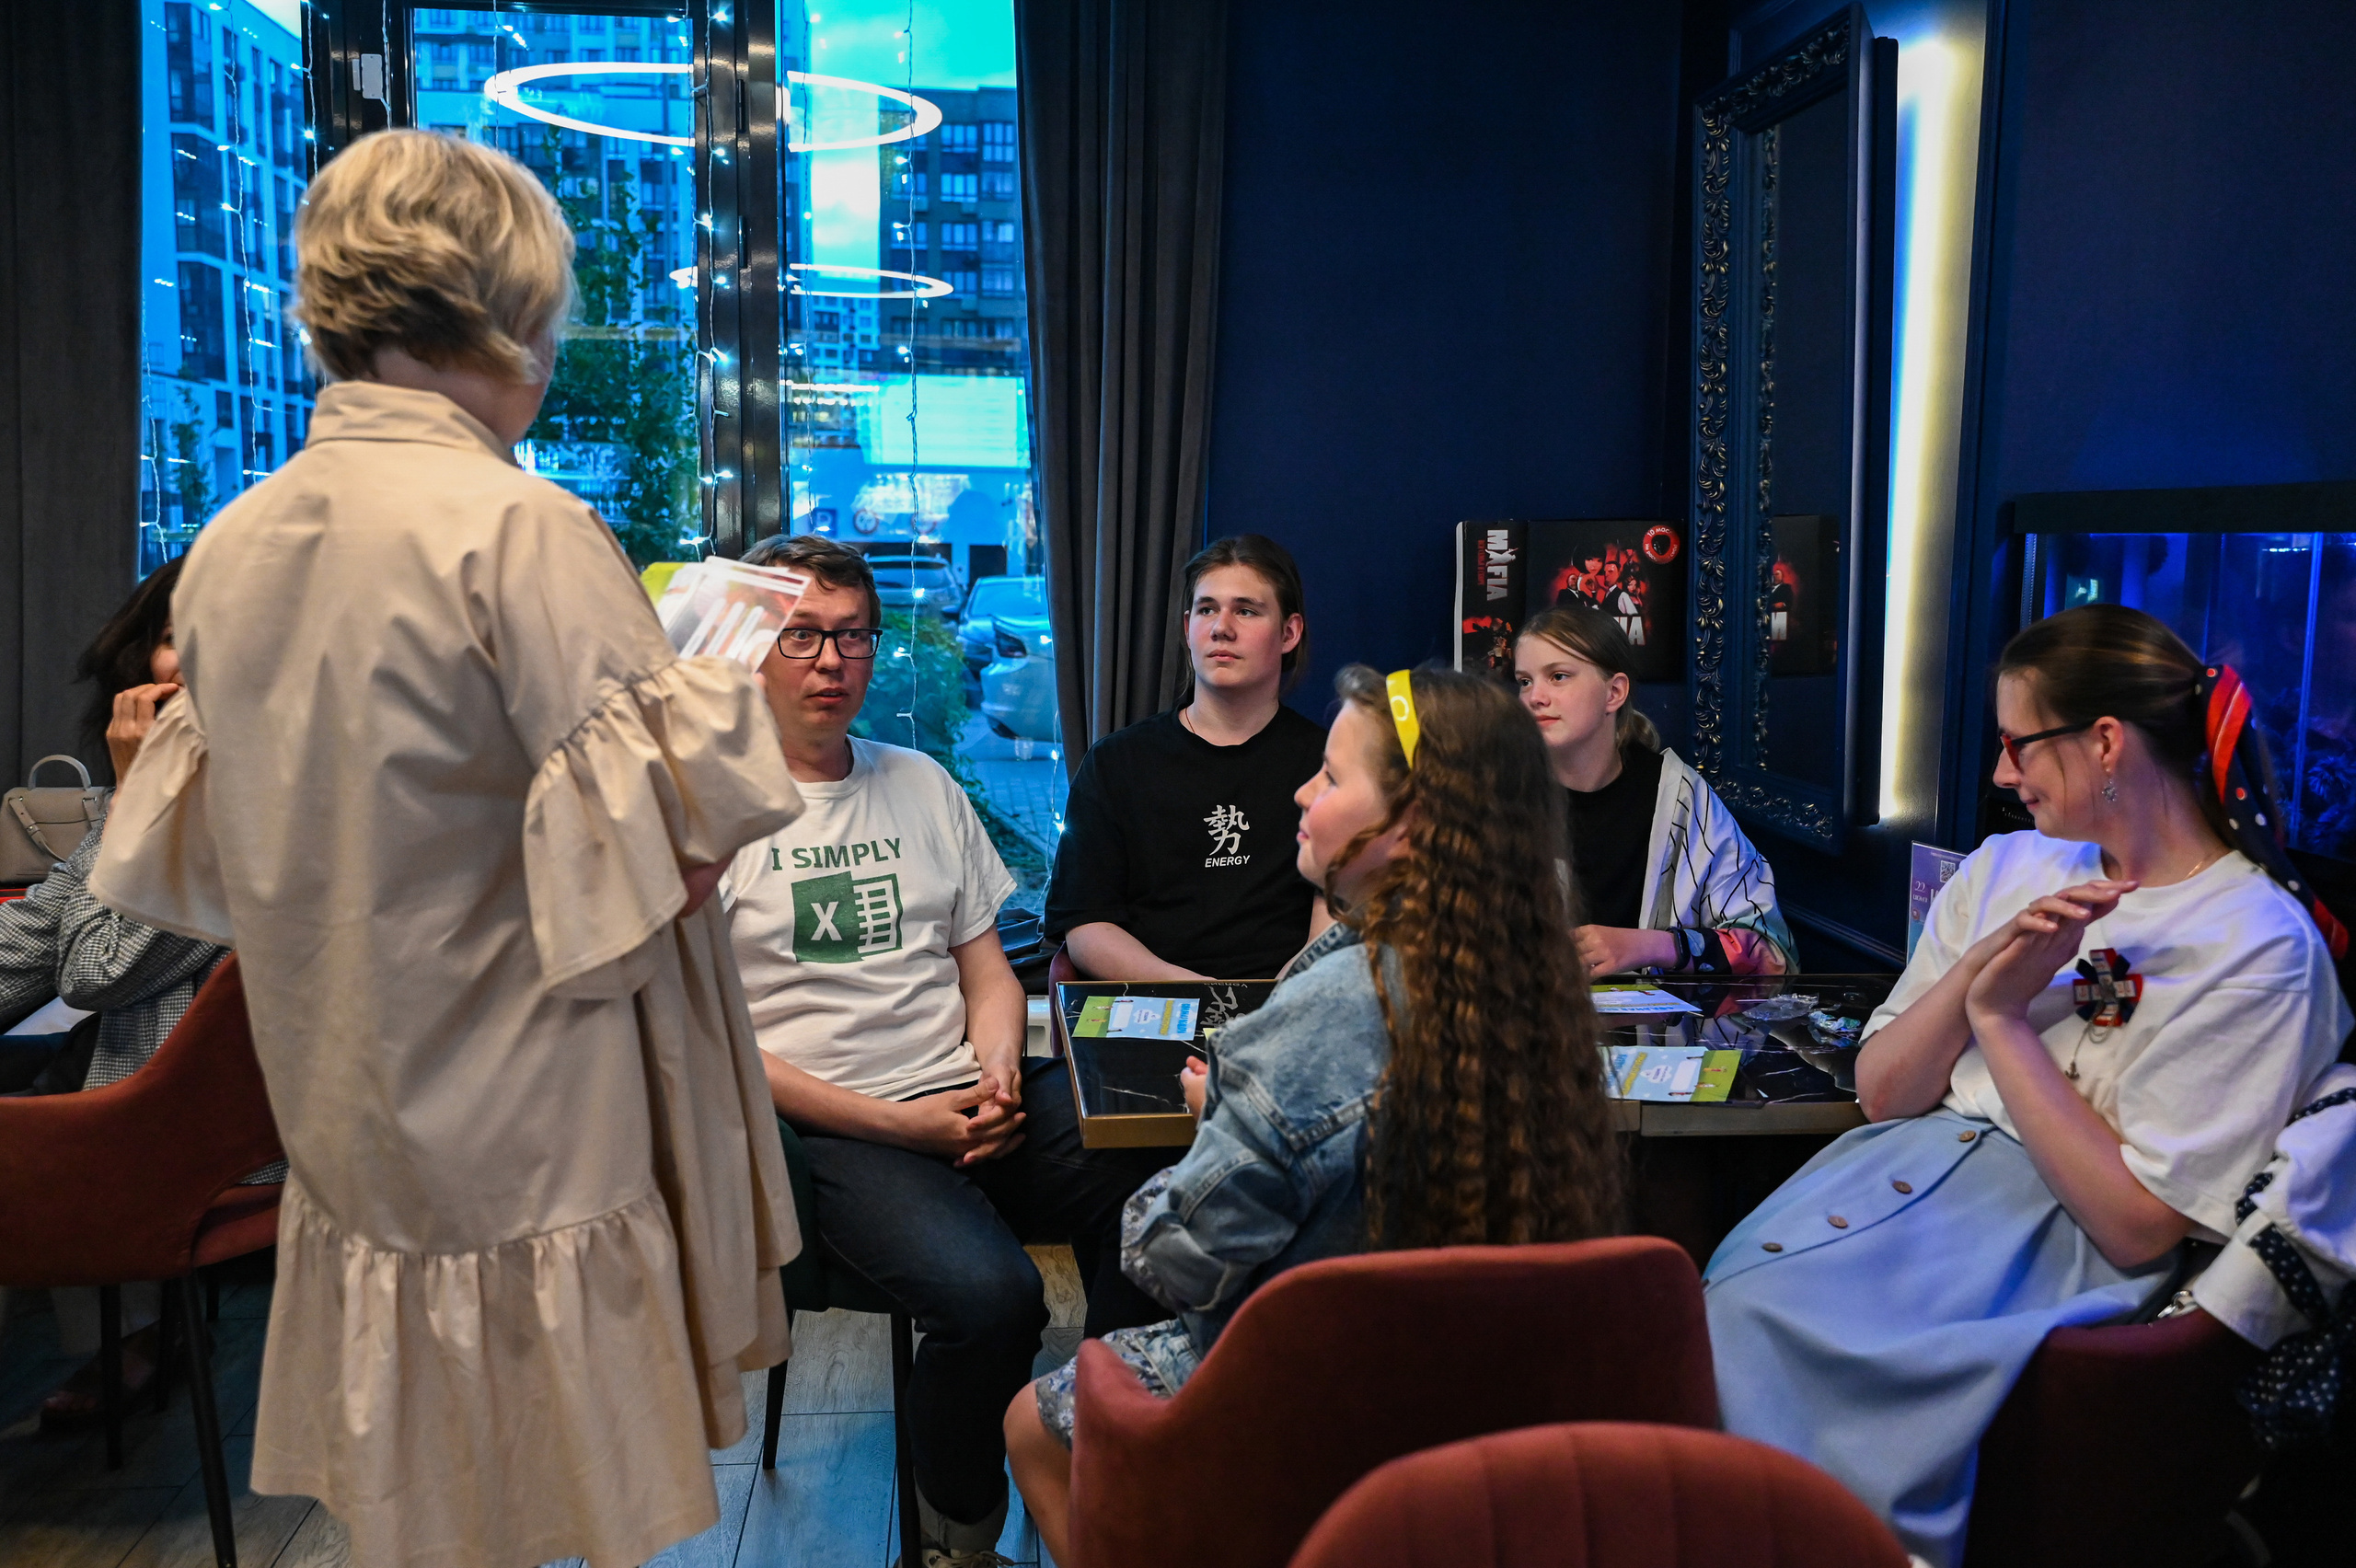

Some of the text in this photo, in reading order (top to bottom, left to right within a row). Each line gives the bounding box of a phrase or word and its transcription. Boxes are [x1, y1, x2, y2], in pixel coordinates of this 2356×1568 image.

[1646, 529, 1656, 537] 10
[1484, 529, 1511, 601] MAFIA
[1203, 804, 1250, 856] 勢
[771, 837, 901, 871] I SIMPLY
[1205, 855, 1251, 868] ENERGY
[810, 901, 843, 941] X
